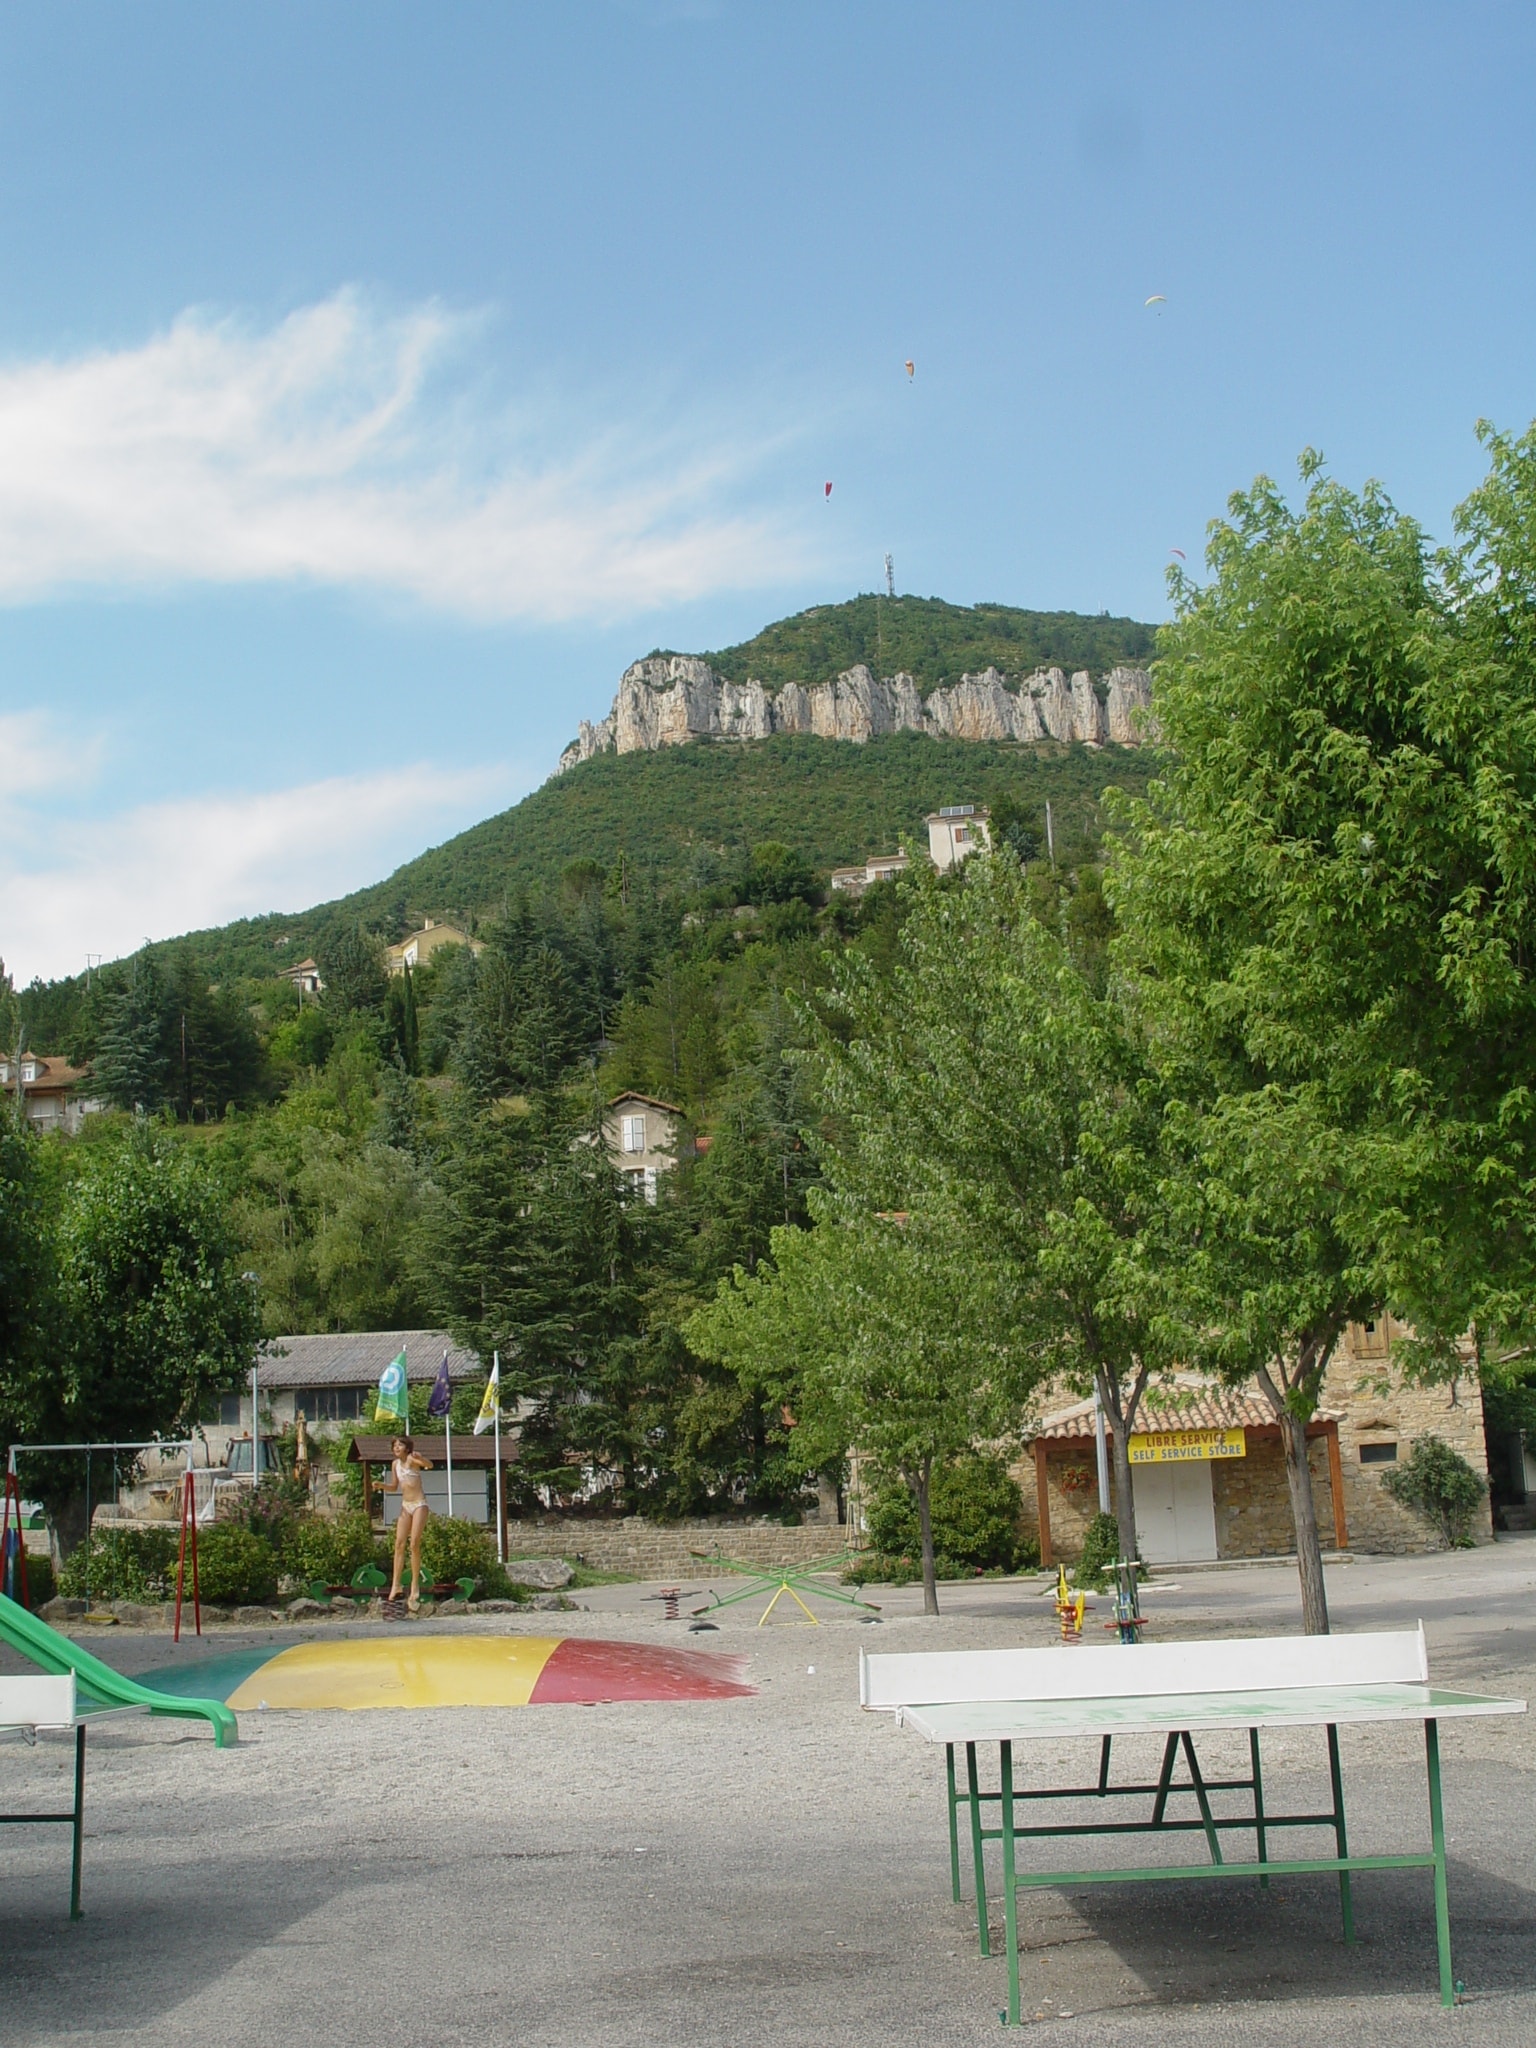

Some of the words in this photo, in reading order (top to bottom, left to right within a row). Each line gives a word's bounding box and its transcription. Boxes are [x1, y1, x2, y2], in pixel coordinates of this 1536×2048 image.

[1146, 1435, 1177, 1448] LIBRE
[1133, 1450, 1155, 1461] SELF
[1161, 1447, 1203, 1459] SERVICE
[1208, 1444, 1241, 1456] STORE
